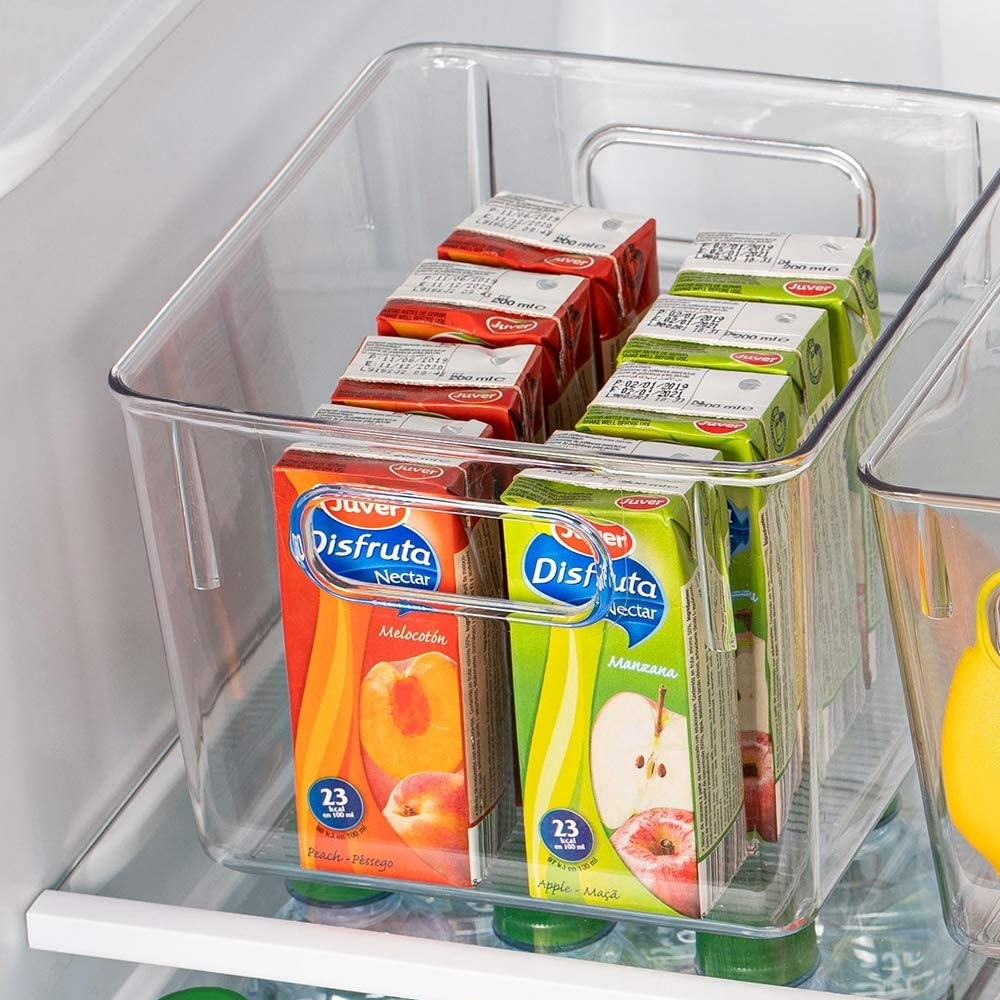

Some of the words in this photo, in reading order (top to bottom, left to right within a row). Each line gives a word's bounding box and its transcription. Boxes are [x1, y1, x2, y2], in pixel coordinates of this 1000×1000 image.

[788, 283, 832, 291] Juver
[491, 321, 533, 330] Juver
[734, 354, 779, 362] Juver
[394, 464, 437, 475] Juver
[330, 499, 399, 517] Juver
[621, 496, 665, 506] Juver
[561, 528, 627, 548] Jer
[312, 529, 432, 567] Disfruta
[374, 569, 431, 586] Nectar
[532, 557, 657, 599] Disfuta
[608, 601, 657, 620] Nectar
[378, 624, 449, 646] Melocotón
[607, 655, 679, 680] Manzana
[320, 788, 348, 806] 23
[552, 819, 579, 837] 23
[307, 847, 343, 863] Peach
[352, 853, 394, 873] Pêssego
[537, 879, 573, 895] Apple
[583, 886, 620, 900] Maçã
